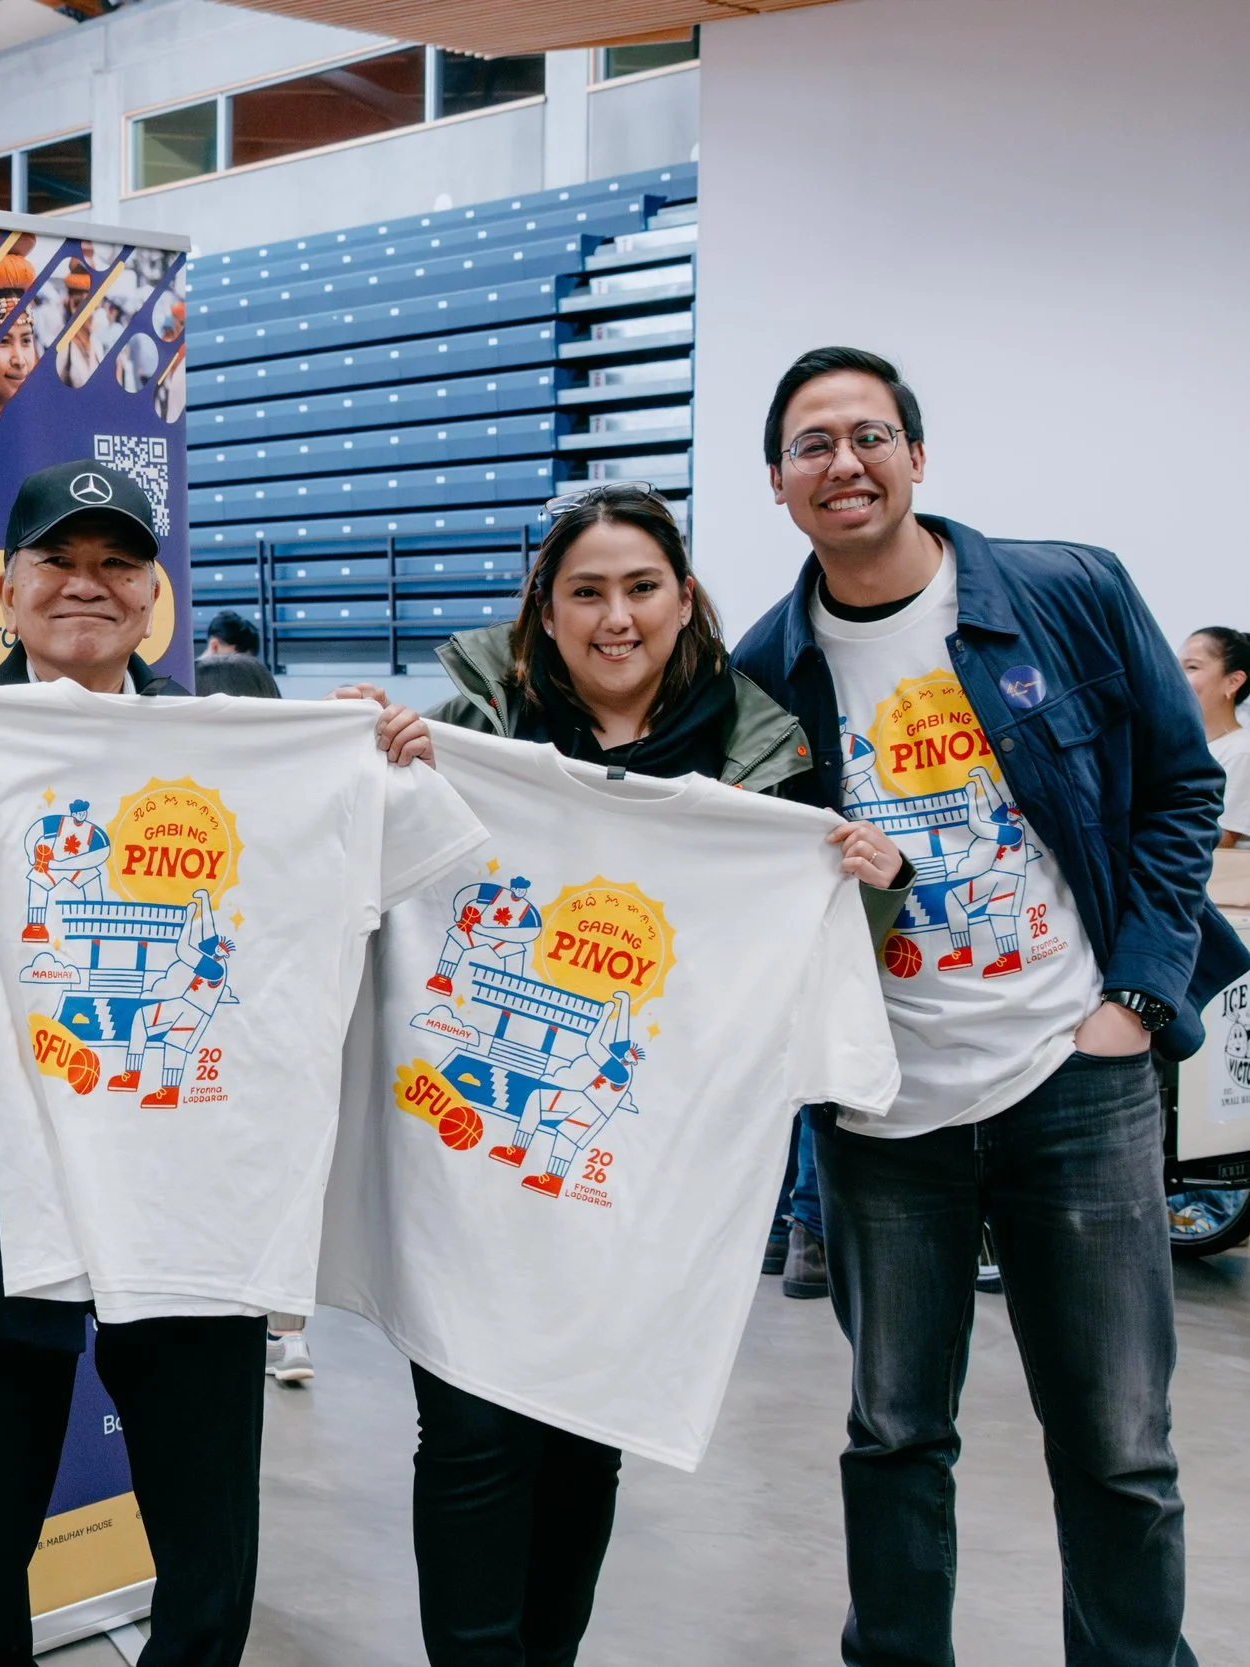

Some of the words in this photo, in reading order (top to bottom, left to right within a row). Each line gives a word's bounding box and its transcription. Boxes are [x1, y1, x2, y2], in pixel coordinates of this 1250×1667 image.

[906, 713, 944, 737] GABI
[950, 712, 972, 725] NG
[890, 728, 991, 773] PINOY
[144, 823, 183, 840] GABI
[187, 826, 207, 844] NG
[121, 844, 225, 879] PINOY
[1026, 904, 1046, 922] 20
[578, 920, 619, 937] GABI
[621, 930, 642, 949] NG
[1031, 922, 1048, 939] 26
[546, 931, 656, 986] PINOY
[32, 970, 73, 979] MABUHAY
[1222, 984, 1248, 1017] ICE
[426, 1018, 472, 1039] MABUHAY
[33, 1029, 71, 1063] SFU
[199, 1048, 222, 1064] 20
[196, 1065, 219, 1081] 26
[405, 1075, 452, 1115] SFU
[587, 1148, 613, 1167] 20
[583, 1165, 607, 1184] 26
[46, 1528, 85, 1547] MABUHAY
[86, 1519, 113, 1534] HOUSE
